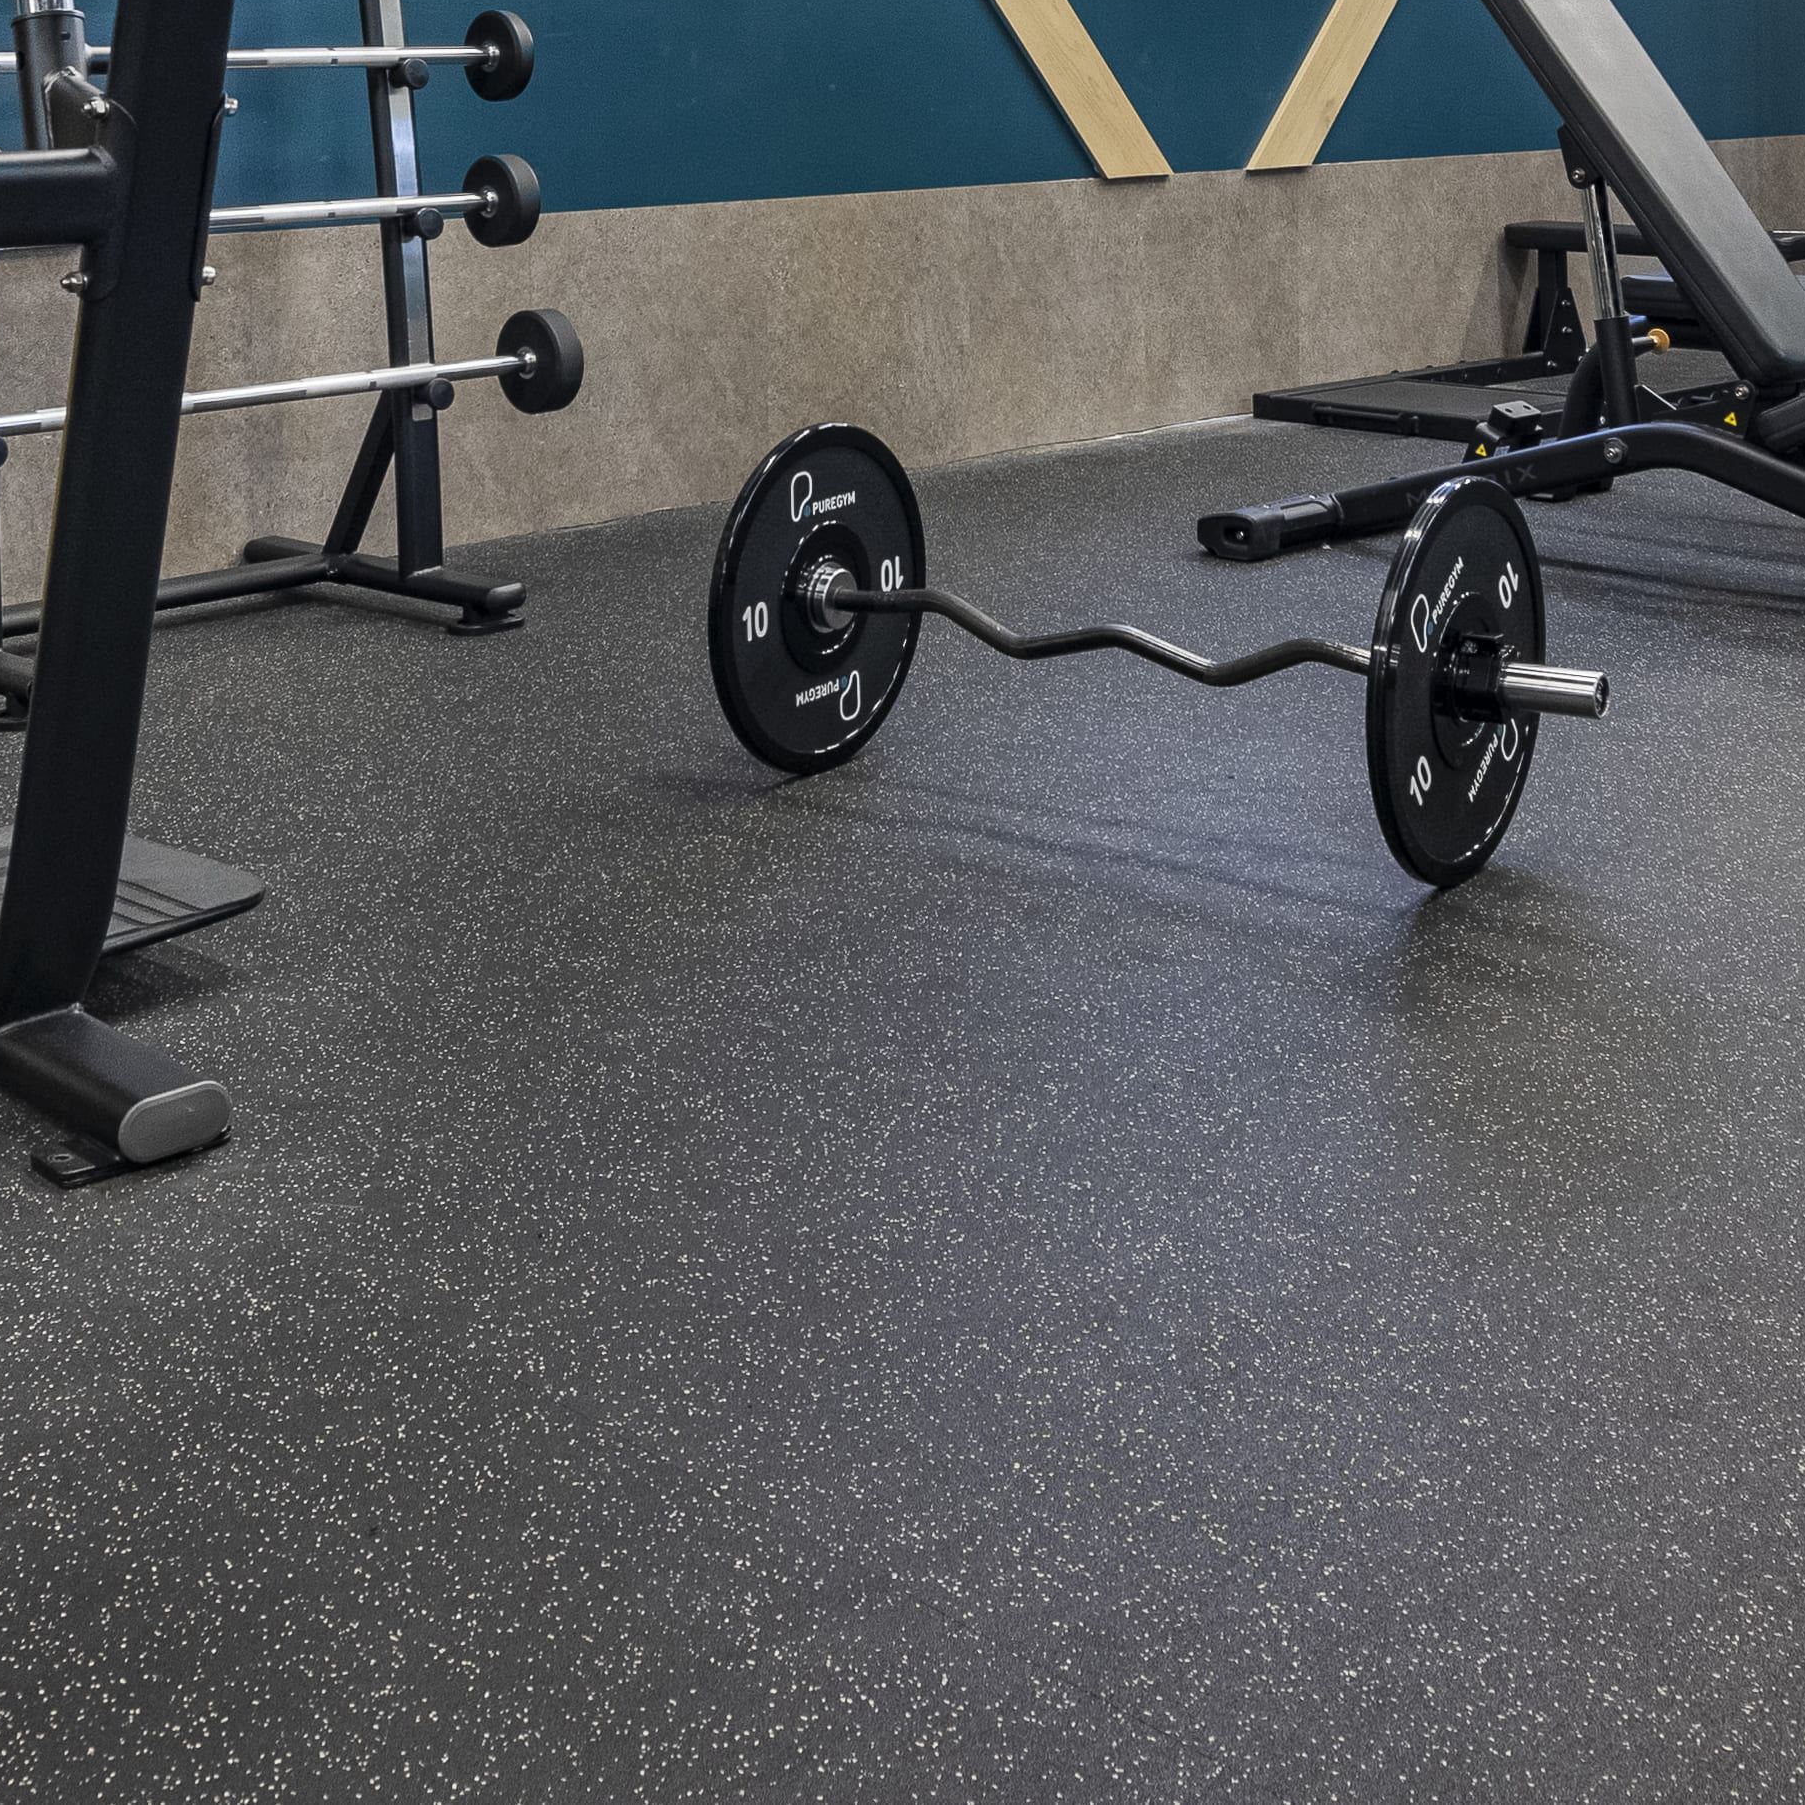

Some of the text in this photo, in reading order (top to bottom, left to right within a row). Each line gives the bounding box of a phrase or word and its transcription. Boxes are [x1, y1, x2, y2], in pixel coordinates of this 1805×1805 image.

[812, 491, 856, 515] PUREGYM
[880, 556, 904, 592] 10
[1432, 556, 1464, 625] PUREGYM
[1499, 561, 1519, 609] 10
[743, 602, 768, 641] 10
[796, 678, 839, 707] PUREGYM
[1410, 756, 1432, 806] 10
[1468, 733, 1498, 803] PUREGYM
